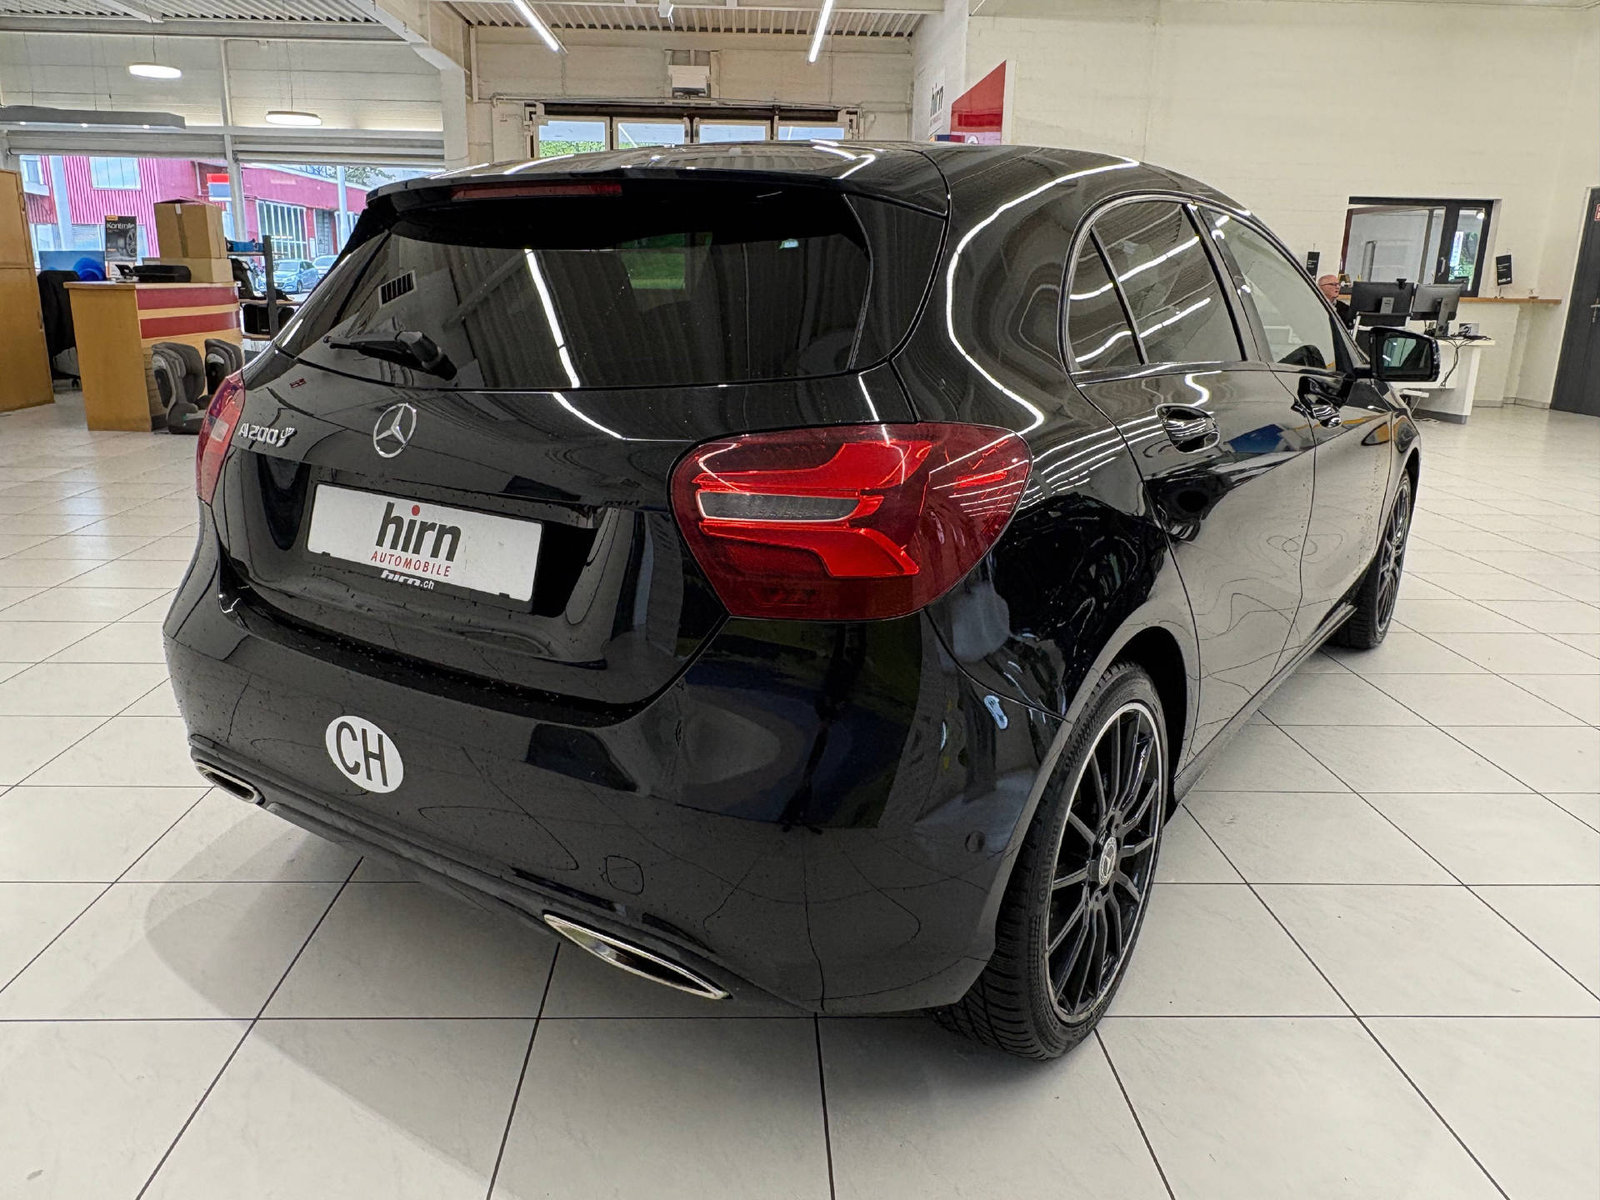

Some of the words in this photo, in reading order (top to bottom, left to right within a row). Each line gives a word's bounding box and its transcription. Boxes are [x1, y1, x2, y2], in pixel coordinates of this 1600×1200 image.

[375, 501, 462, 562] hirn
[370, 550, 452, 578] AUTOMOBILE
[335, 720, 389, 787] CH
